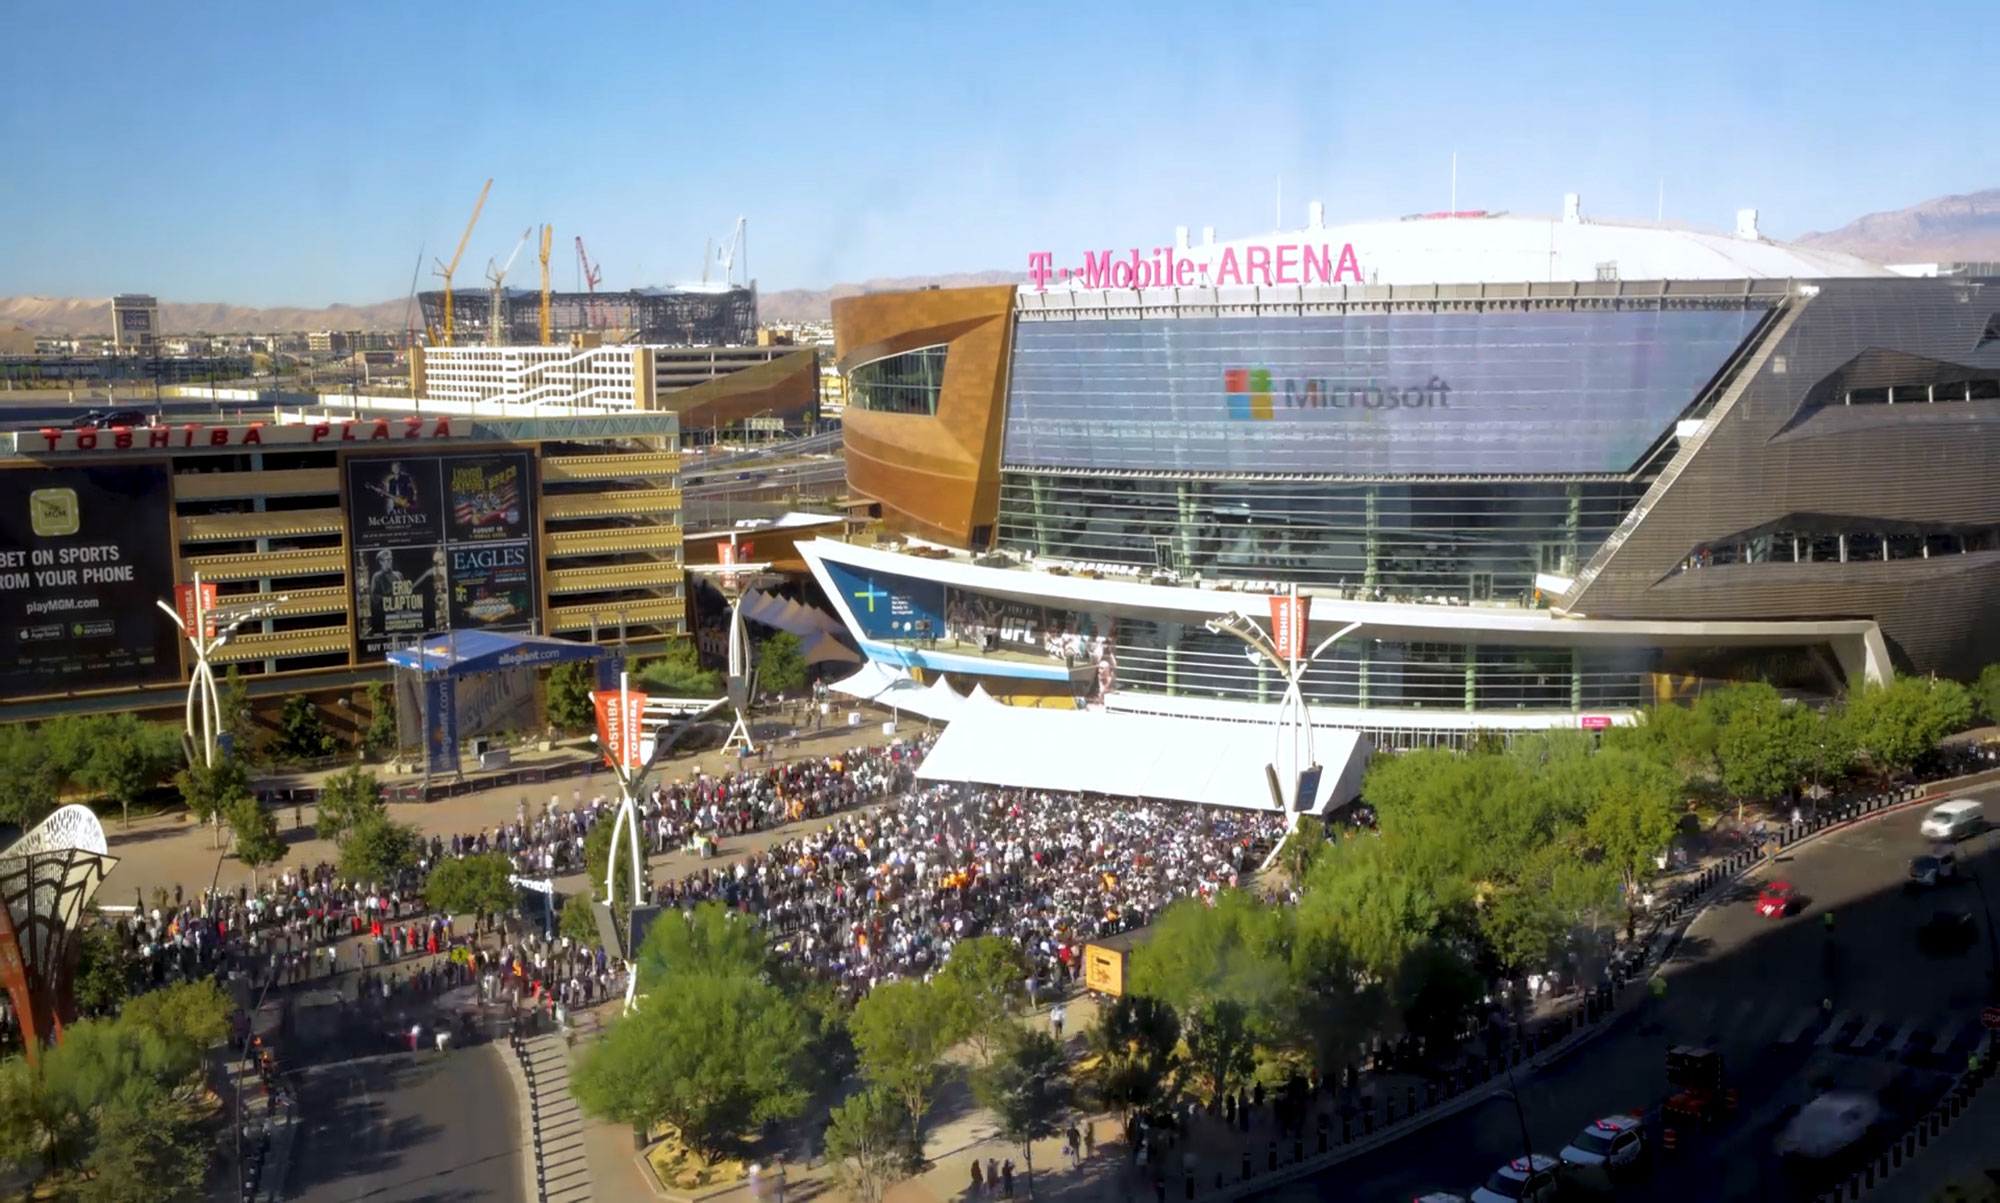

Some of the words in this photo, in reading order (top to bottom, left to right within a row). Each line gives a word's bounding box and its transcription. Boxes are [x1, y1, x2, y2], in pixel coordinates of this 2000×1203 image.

[1216, 243, 1364, 287] ARENA
[1285, 374, 1453, 409] Microsoft
[43, 427, 261, 450] TOSHIBA
[312, 421, 450, 443] PLAZA
[44, 510, 67, 518] MGM
[368, 514, 428, 526] McCARTNEY
[31, 550, 54, 565] ON
[59, 545, 120, 564] SPORTS
[454, 548, 525, 569] EAGLES
[35, 569, 77, 587] YOUR
[83, 566, 134, 584] PHONE
[392, 580, 413, 596] ERIC
[26, 598, 100, 615] playMGM.com
[184, 589, 195, 633] TOSHIBA
[382, 594, 424, 611] CLAPTON
[1001, 616, 1038, 645] UFC
[1279, 602, 1289, 652] TOSHIBA
[367, 643, 381, 652] BUY
[498, 650, 560, 665] allegiant.com
[630, 698, 639, 759] TOSHIBA
